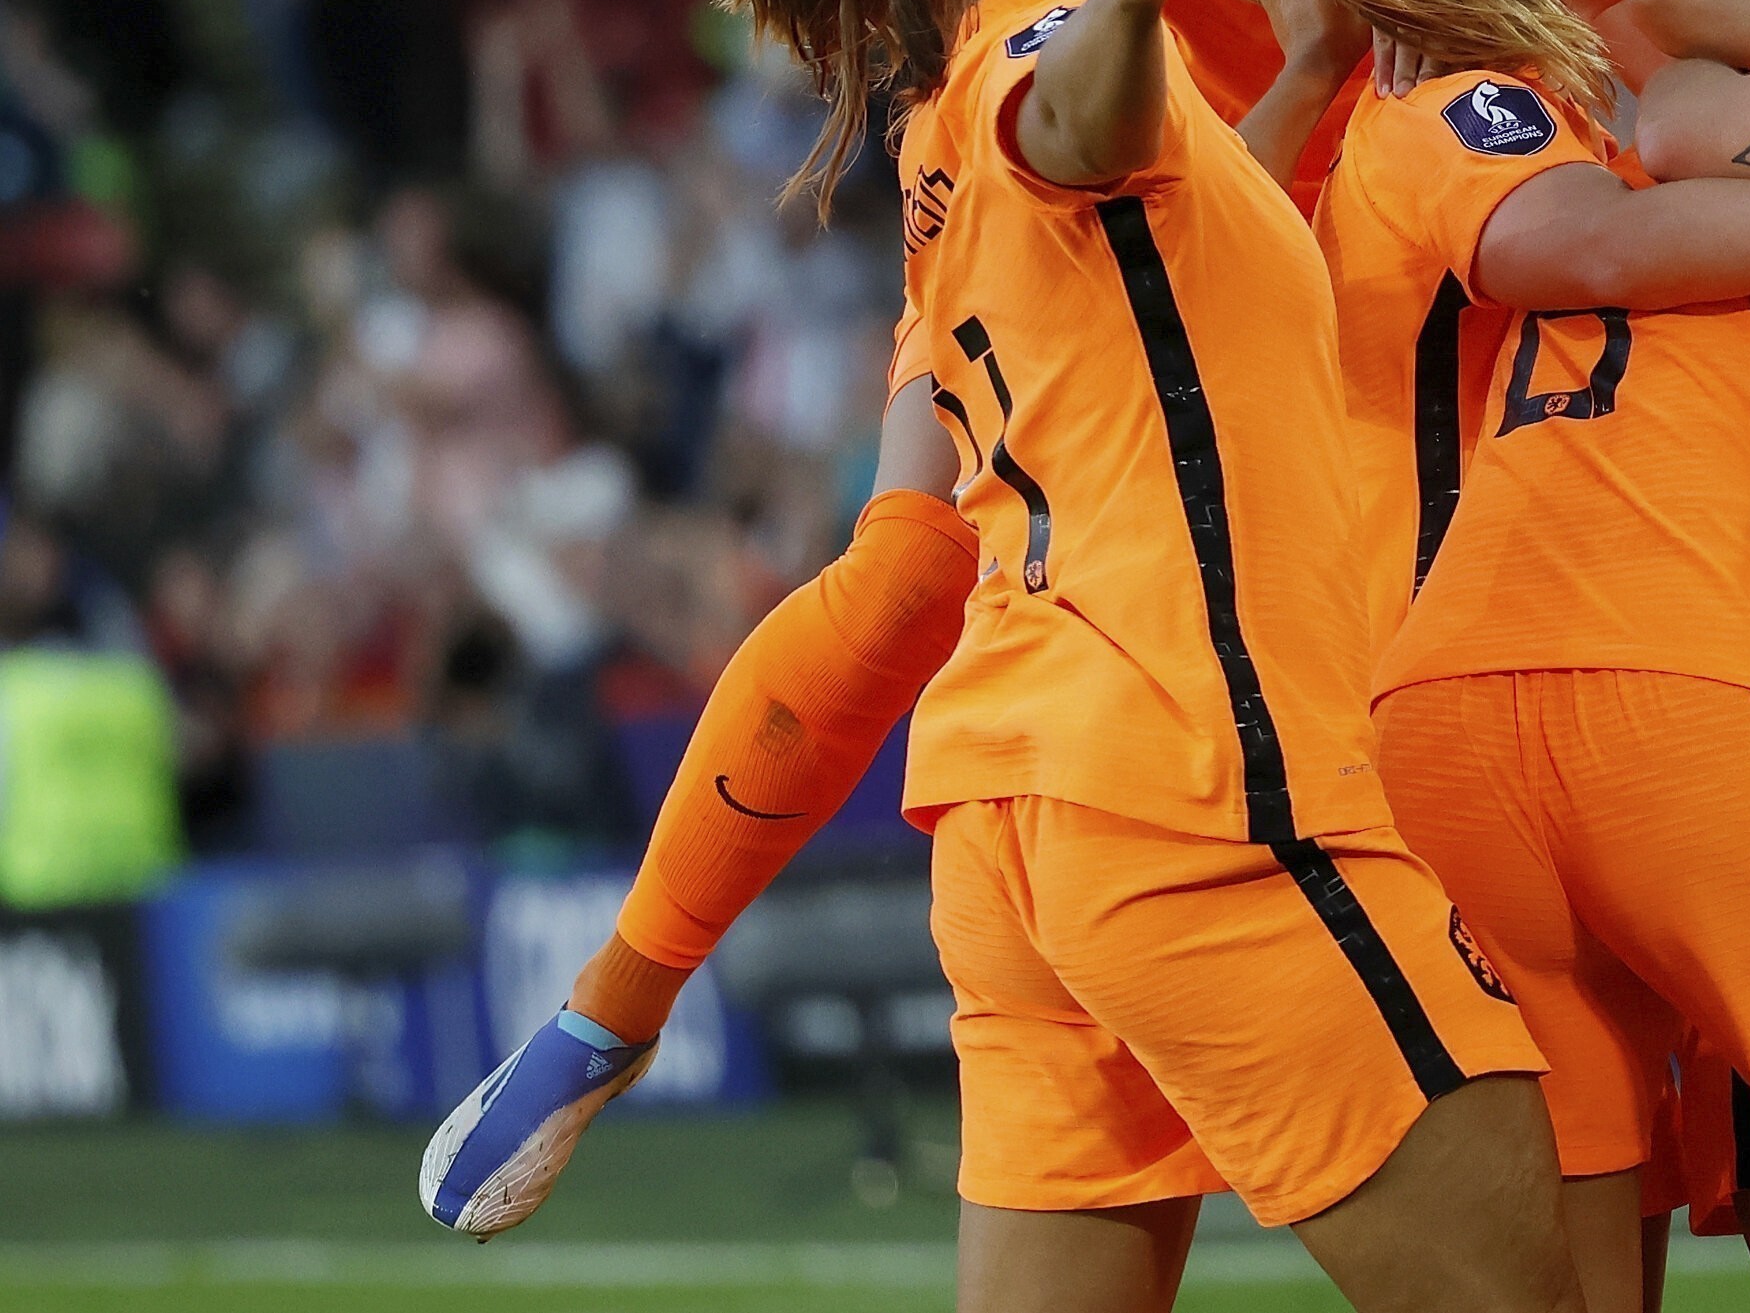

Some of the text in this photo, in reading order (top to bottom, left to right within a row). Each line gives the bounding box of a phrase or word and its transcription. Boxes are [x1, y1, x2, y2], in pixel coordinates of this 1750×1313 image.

[1482, 125, 1538, 143] EUROPEAN
[1490, 122, 1519, 135] UEFA
[1483, 131, 1544, 148] CHAMPIONS
